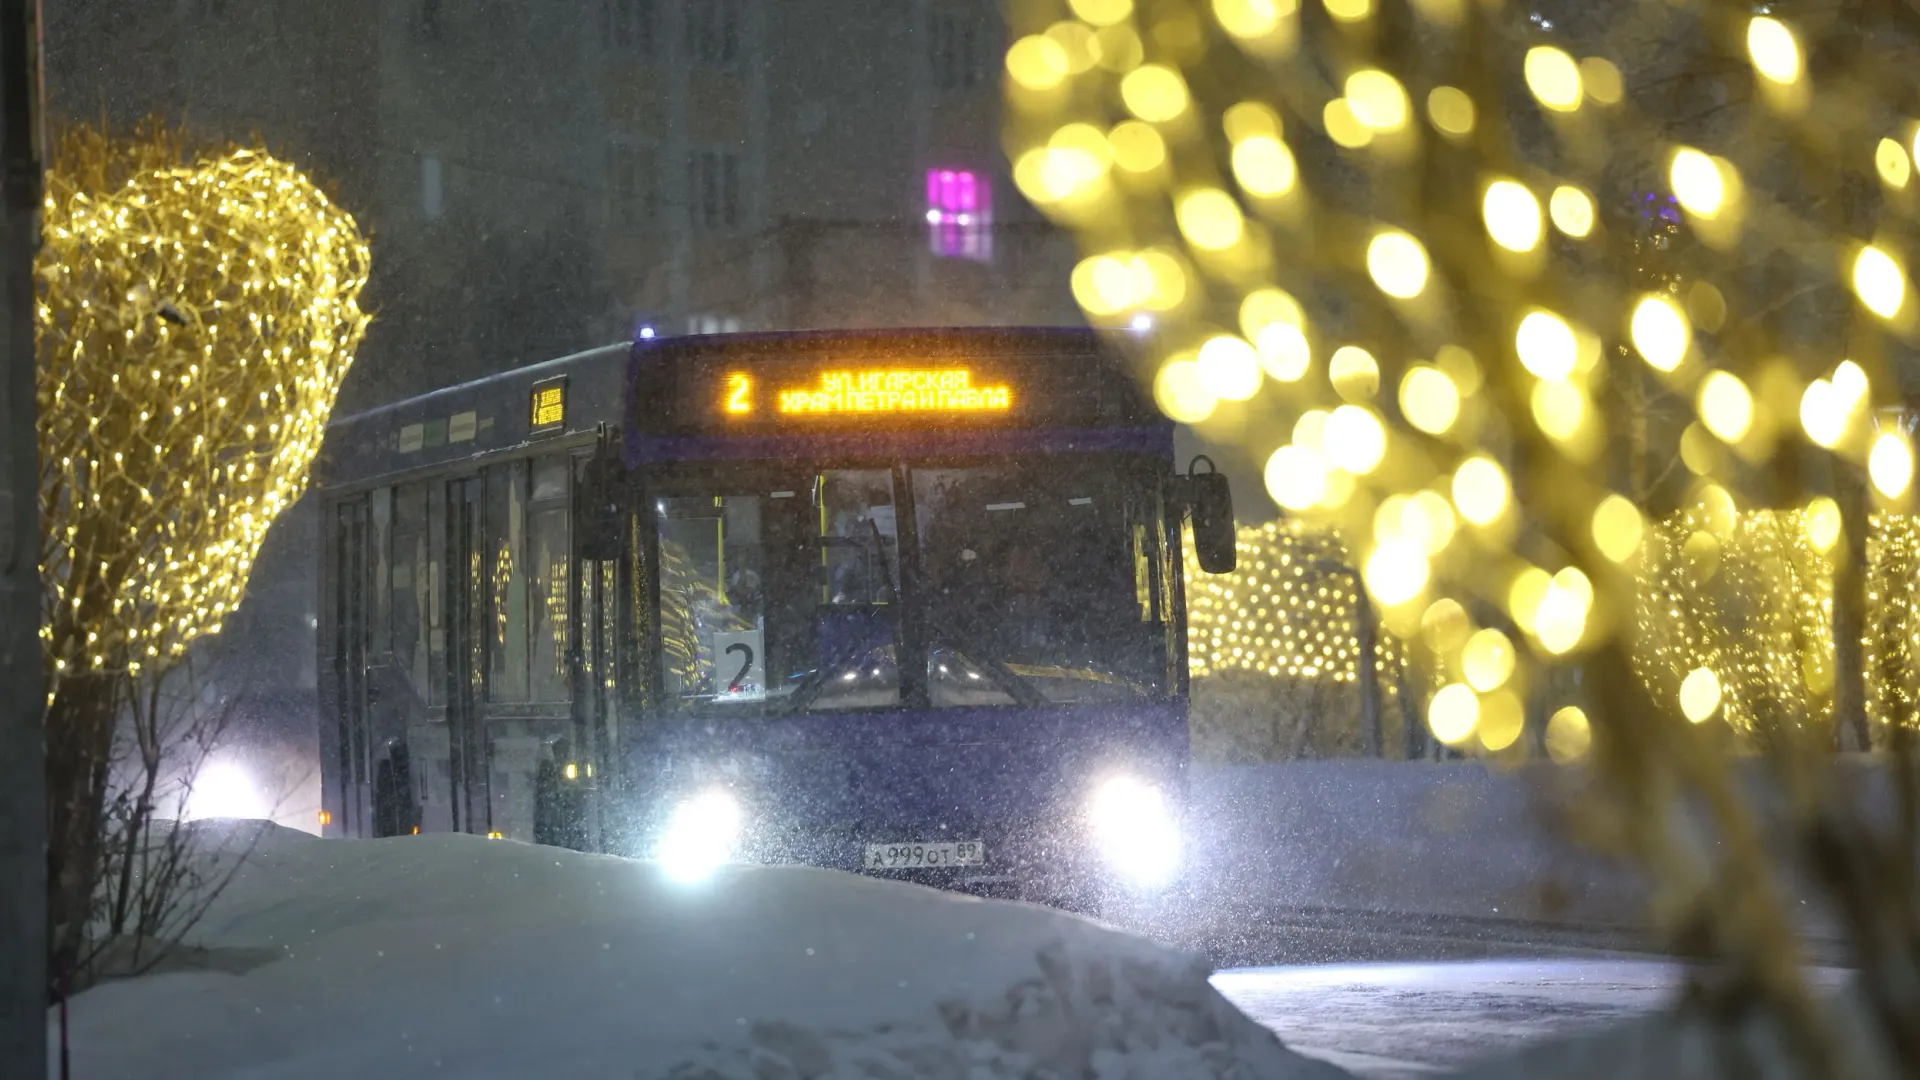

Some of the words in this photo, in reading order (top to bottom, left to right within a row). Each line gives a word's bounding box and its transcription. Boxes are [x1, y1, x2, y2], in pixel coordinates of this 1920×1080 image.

[727, 375, 750, 413] 2
[859, 369, 968, 390] ИГАРСКАЯ
[781, 391, 842, 412] ХРАМ
[846, 390, 916, 410] ПЕТРА
[919, 389, 934, 409] И
[938, 387, 1007, 408] ПАВЛА
[725, 642, 759, 692] 2
